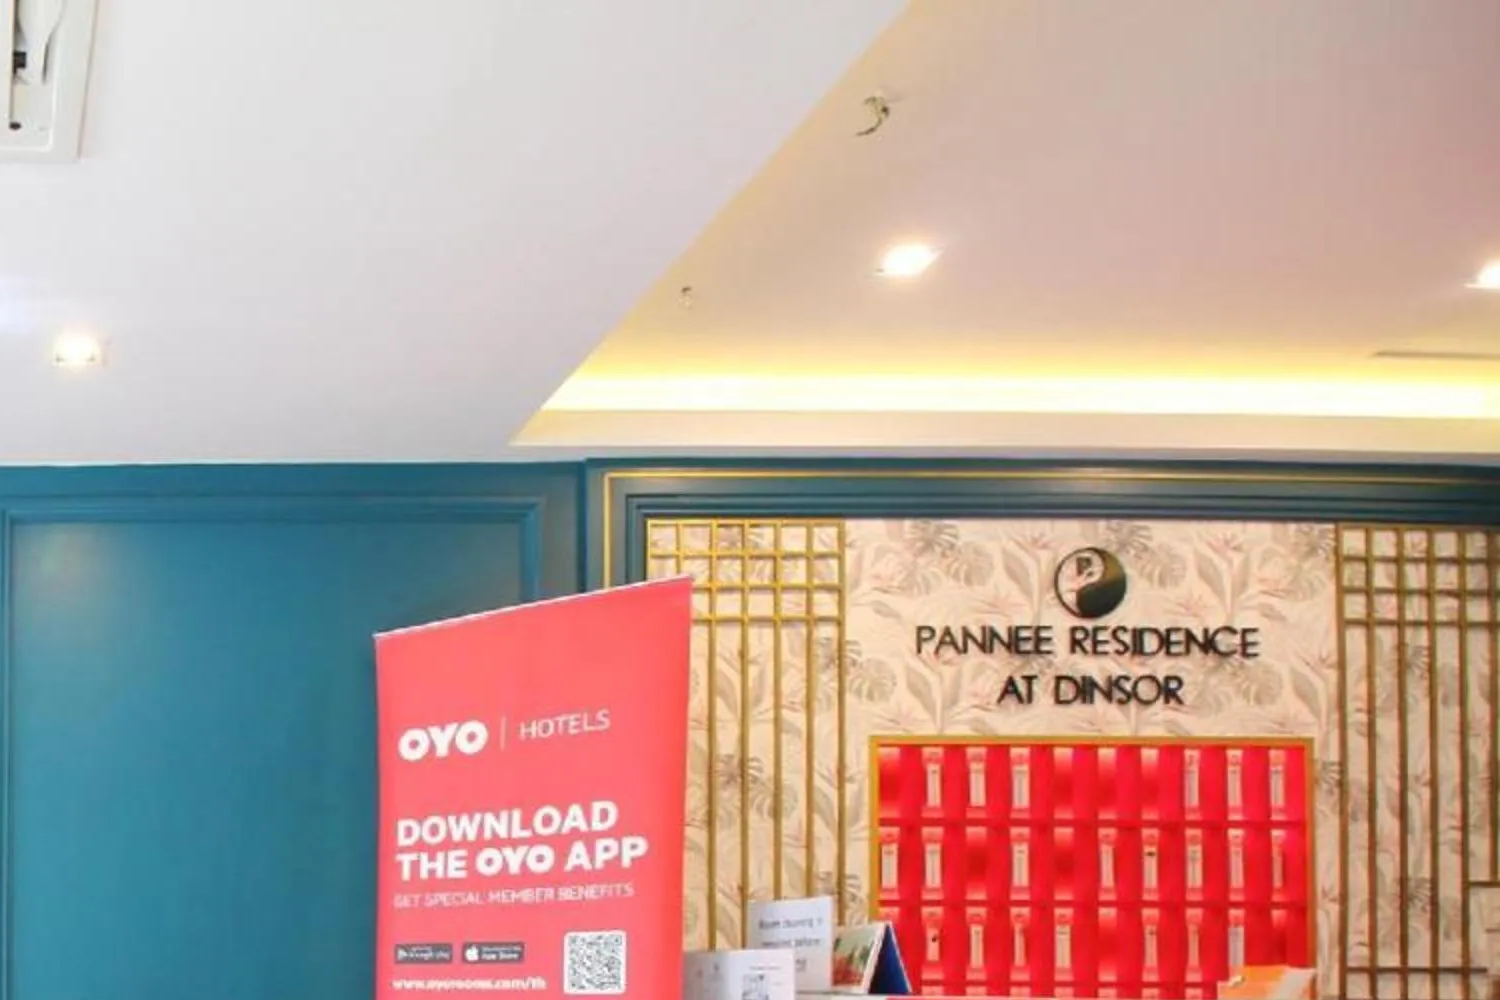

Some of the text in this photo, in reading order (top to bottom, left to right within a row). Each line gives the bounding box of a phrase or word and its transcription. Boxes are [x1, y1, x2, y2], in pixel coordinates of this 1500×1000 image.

[915, 625, 1260, 658] PANNEE RESIDENCE
[997, 674, 1186, 706] AT DINSOR
[398, 708, 611, 761] OYO HOTELS
[395, 799, 619, 848] DOWNLOAD
[395, 835, 648, 881] THE OYO APP
[394, 882, 635, 909] GET SPECIAL MEMBER BENEFITS
